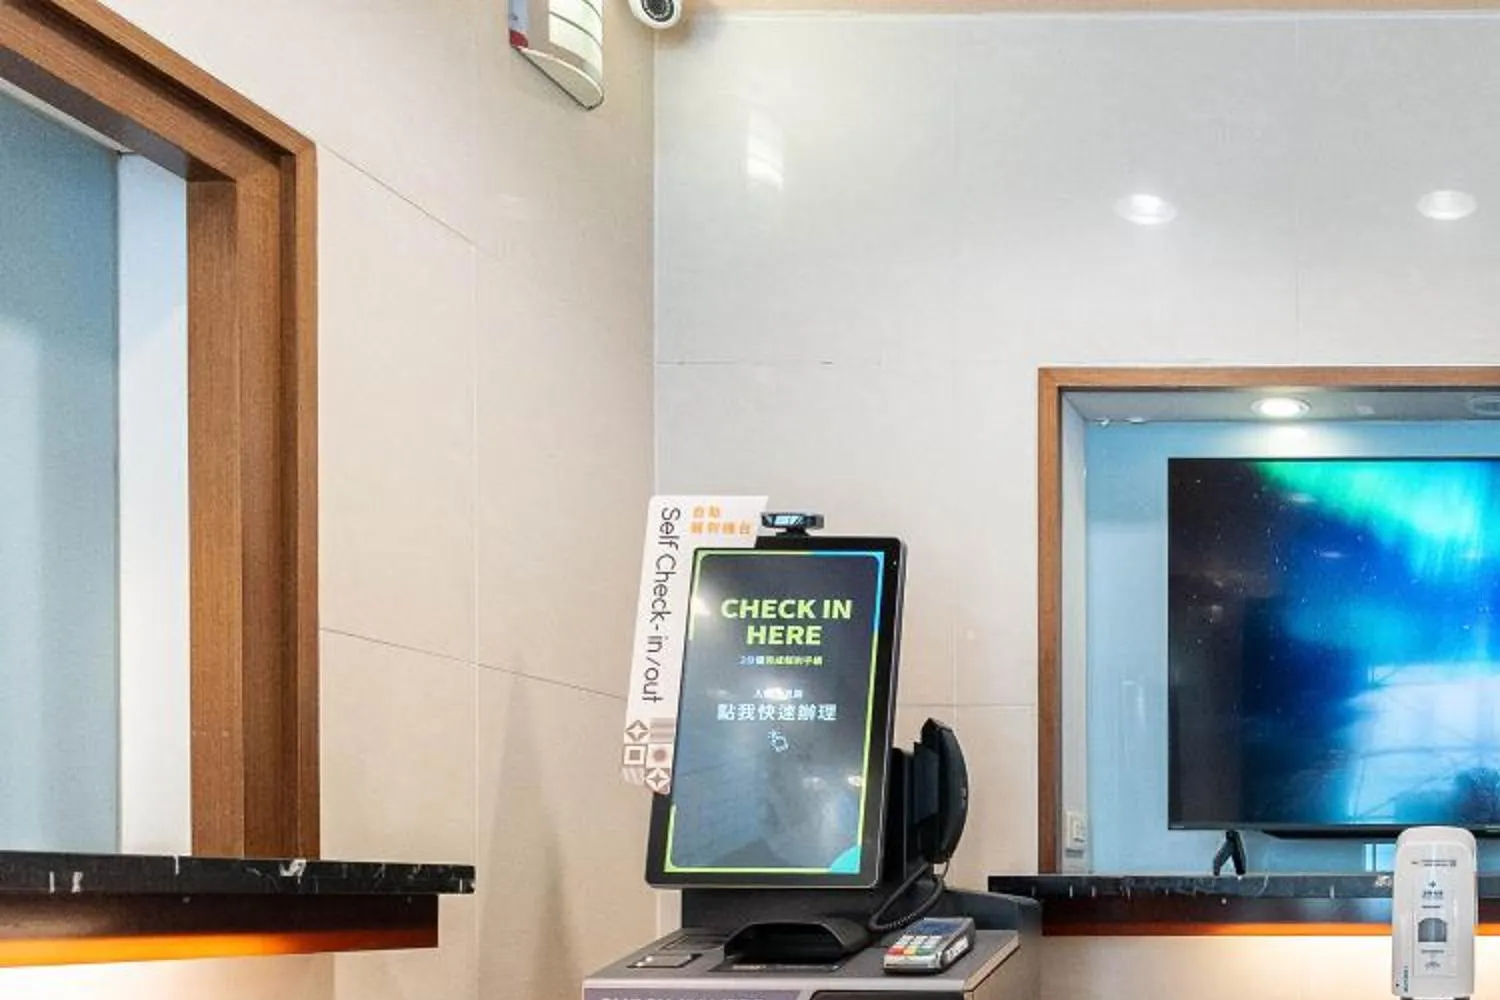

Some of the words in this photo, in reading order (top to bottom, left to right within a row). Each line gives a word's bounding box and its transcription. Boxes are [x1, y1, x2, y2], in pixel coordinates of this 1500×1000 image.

[659, 507, 681, 550] Self
[721, 599, 816, 620] CHECK
[823, 599, 852, 620] IN
[747, 625, 822, 645] HERE
[717, 703, 837, 721] 點我快速辦理
